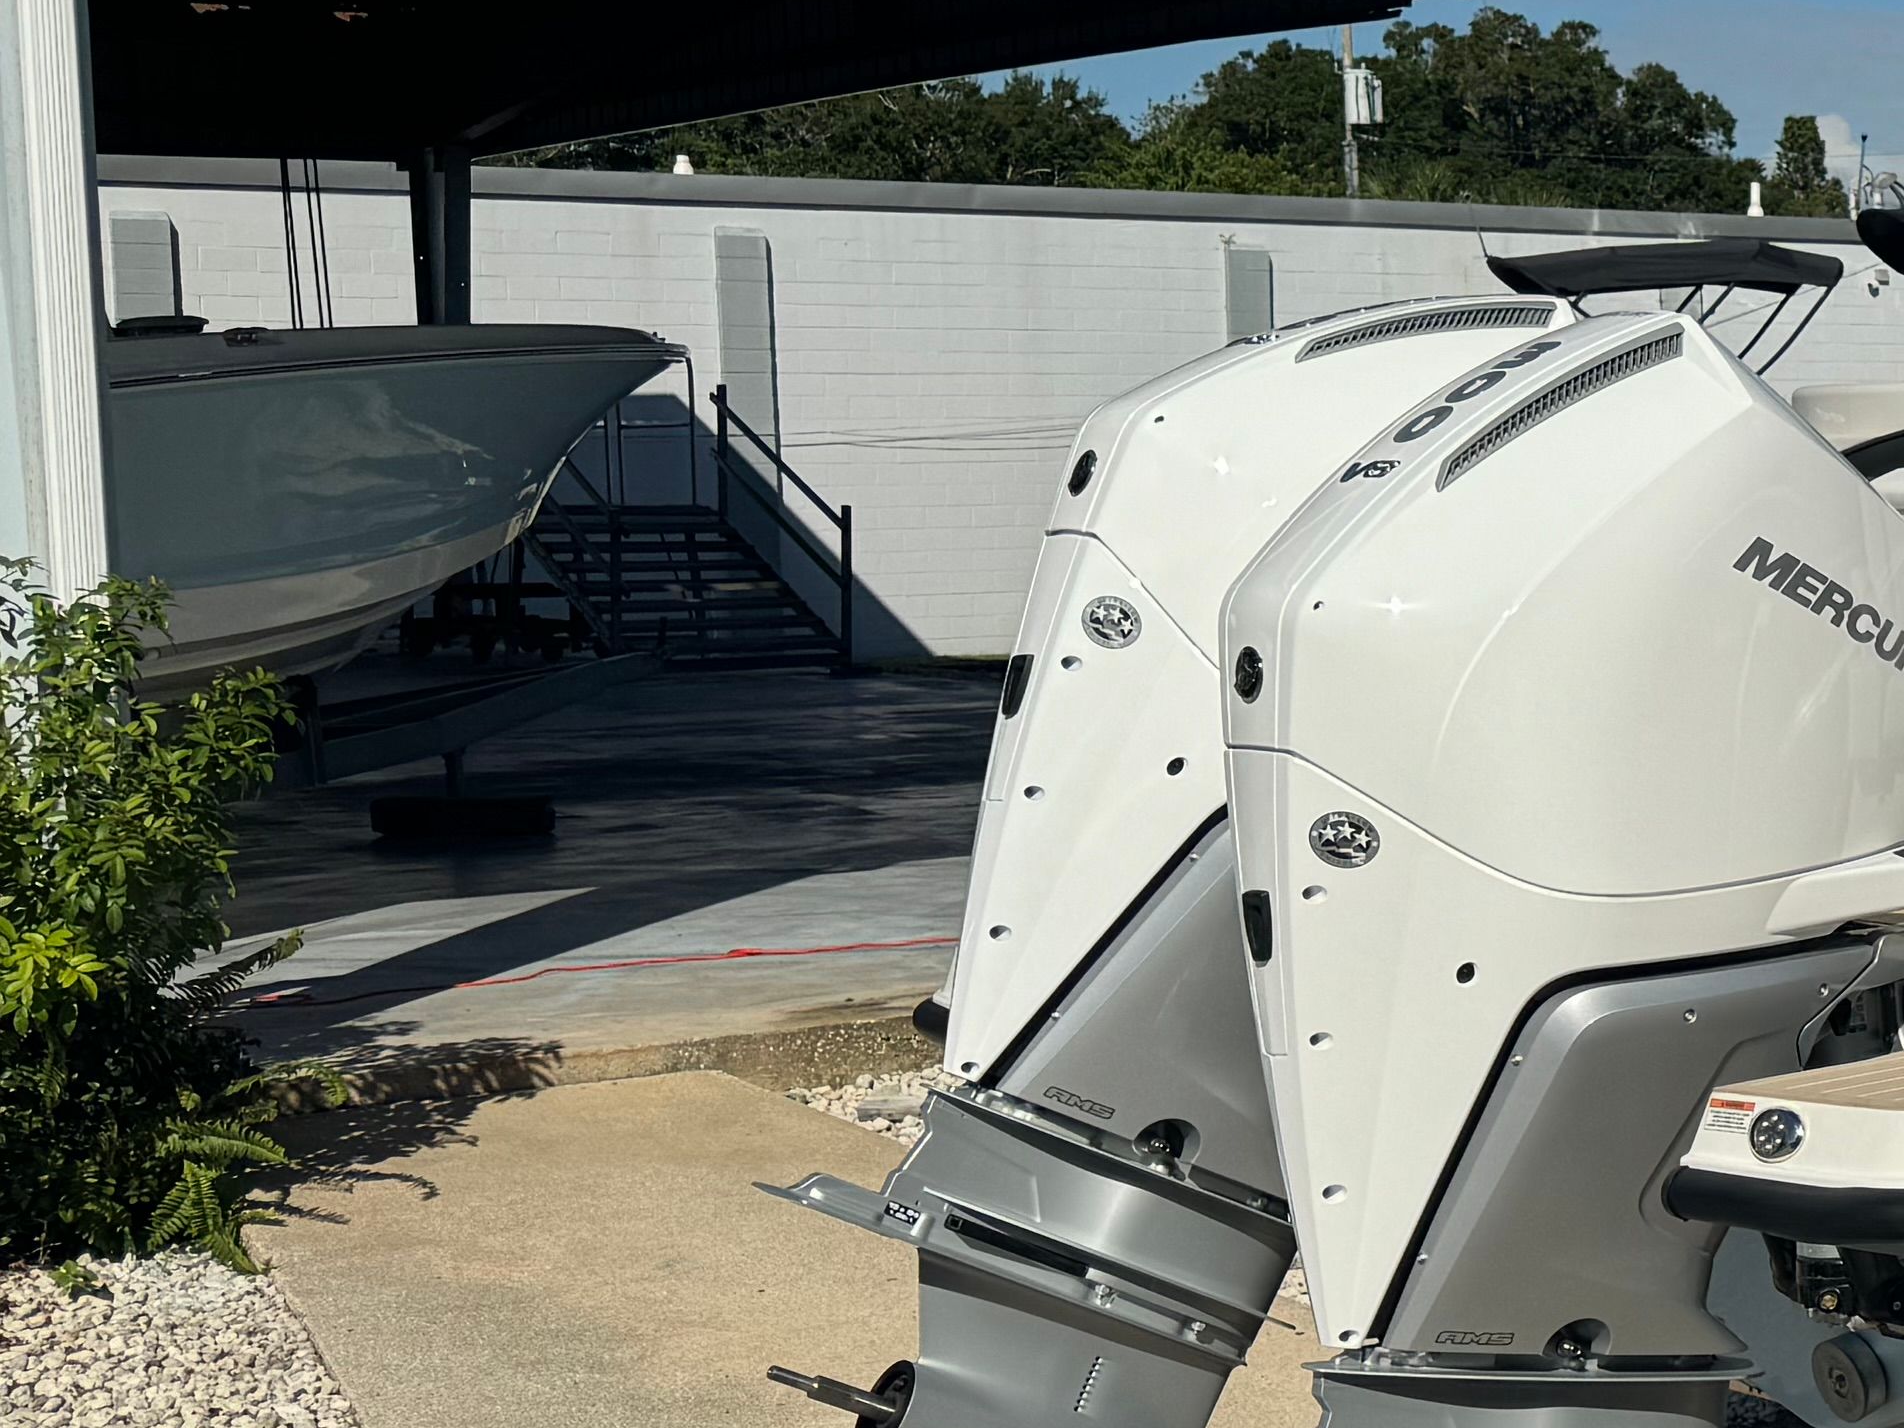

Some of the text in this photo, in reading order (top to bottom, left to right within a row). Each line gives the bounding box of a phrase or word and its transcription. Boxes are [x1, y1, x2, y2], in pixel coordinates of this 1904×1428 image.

[1393, 341, 1562, 443] 300
[1043, 1086, 1116, 1120] AMS
[1435, 1330, 1515, 1345] AMS
